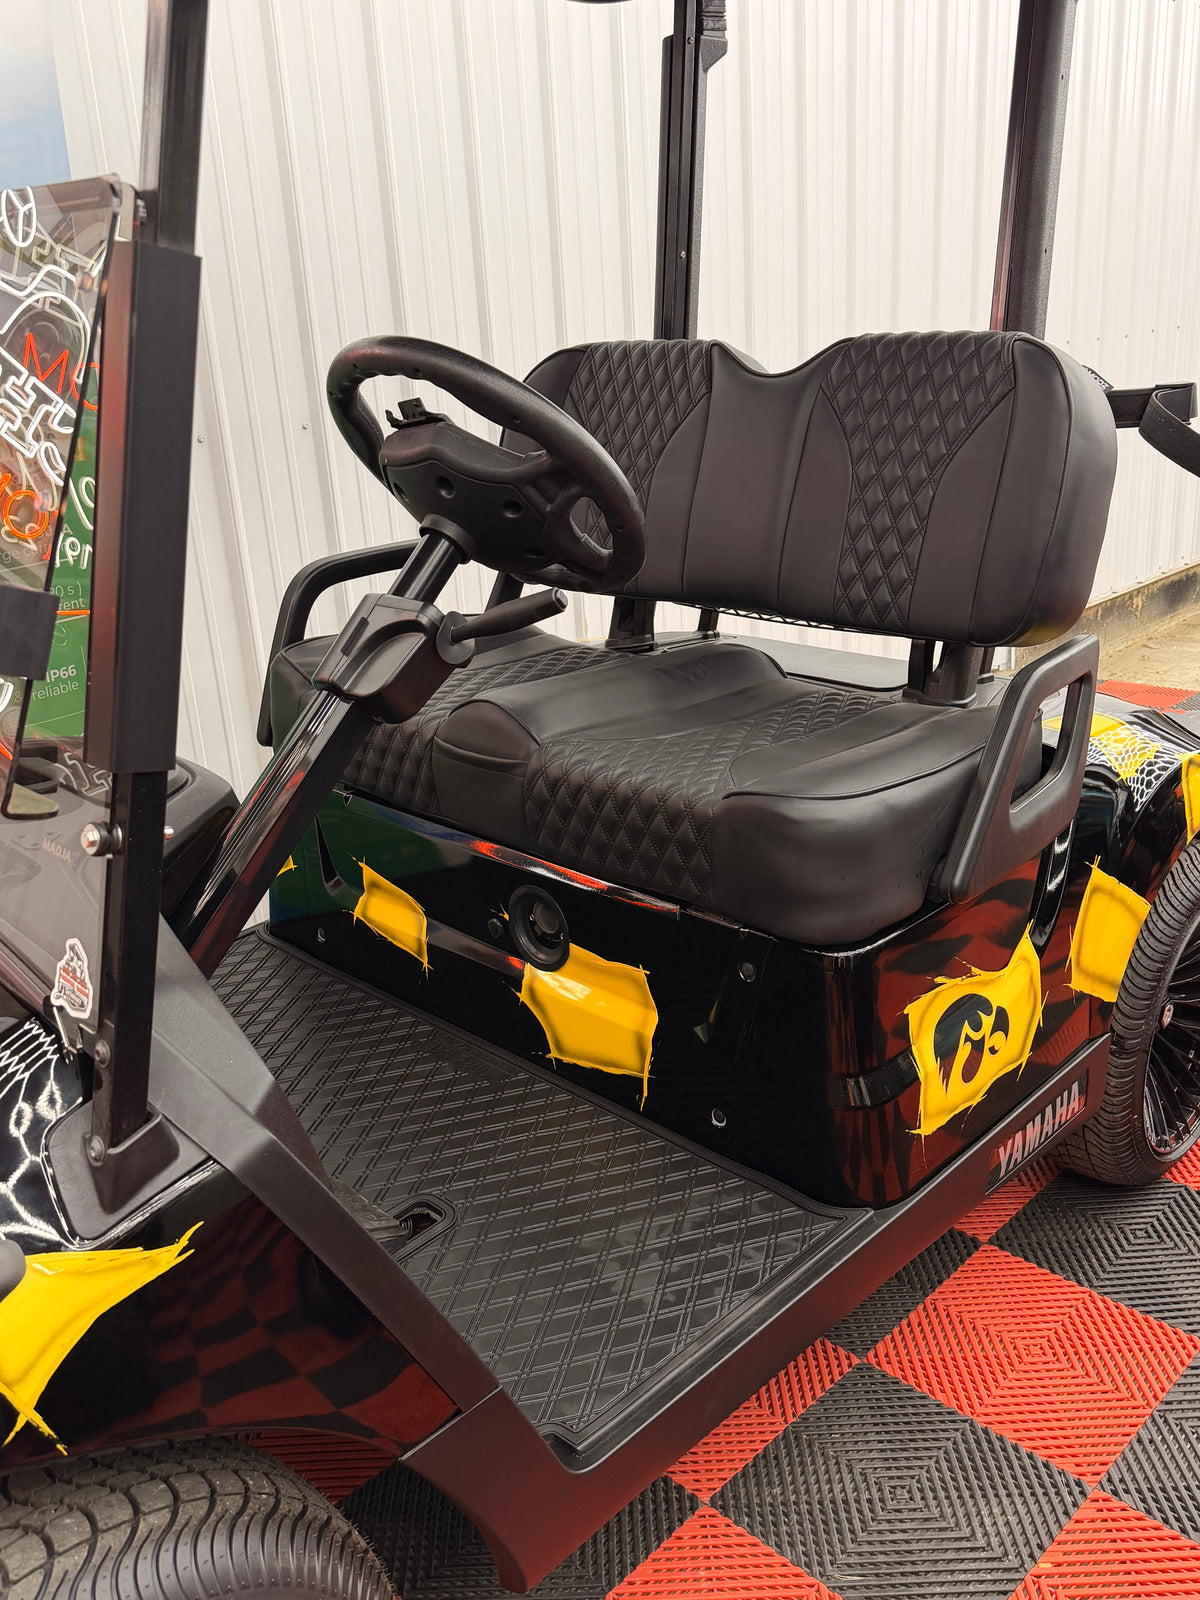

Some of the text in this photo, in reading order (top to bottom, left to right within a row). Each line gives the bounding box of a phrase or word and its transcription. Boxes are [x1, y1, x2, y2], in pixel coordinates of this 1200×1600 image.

[46, 664, 77, 683] IP66
[32, 680, 79, 701] reliable
[998, 1080, 1080, 1178] YAMAHA
